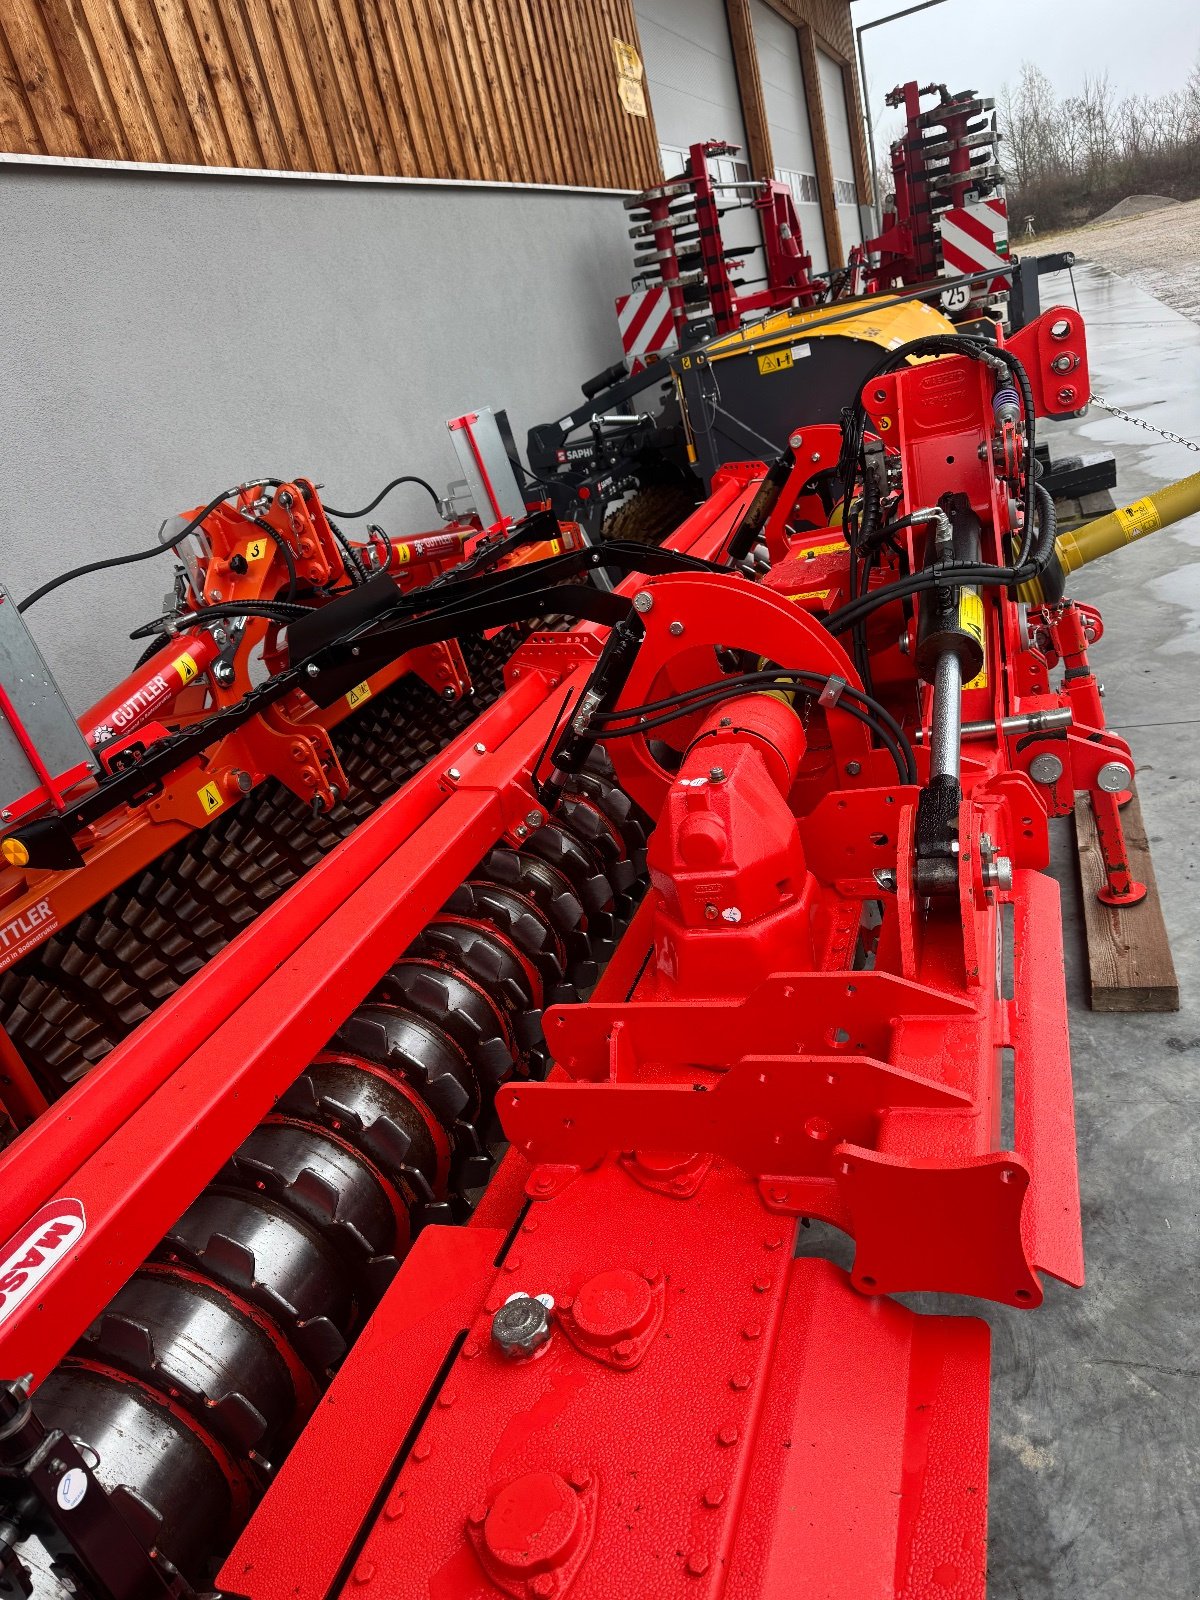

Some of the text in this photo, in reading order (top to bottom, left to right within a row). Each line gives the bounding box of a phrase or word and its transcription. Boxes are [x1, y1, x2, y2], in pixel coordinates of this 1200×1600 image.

[947, 286, 965, 306] 25
[566, 447, 593, 460] SAPHI
[111, 674, 168, 727] GÜTTLER
[0, 901, 53, 949] TTLER
[18, 921, 59, 954] Bodenstruktur
[0, 1222, 75, 1309] MAS
